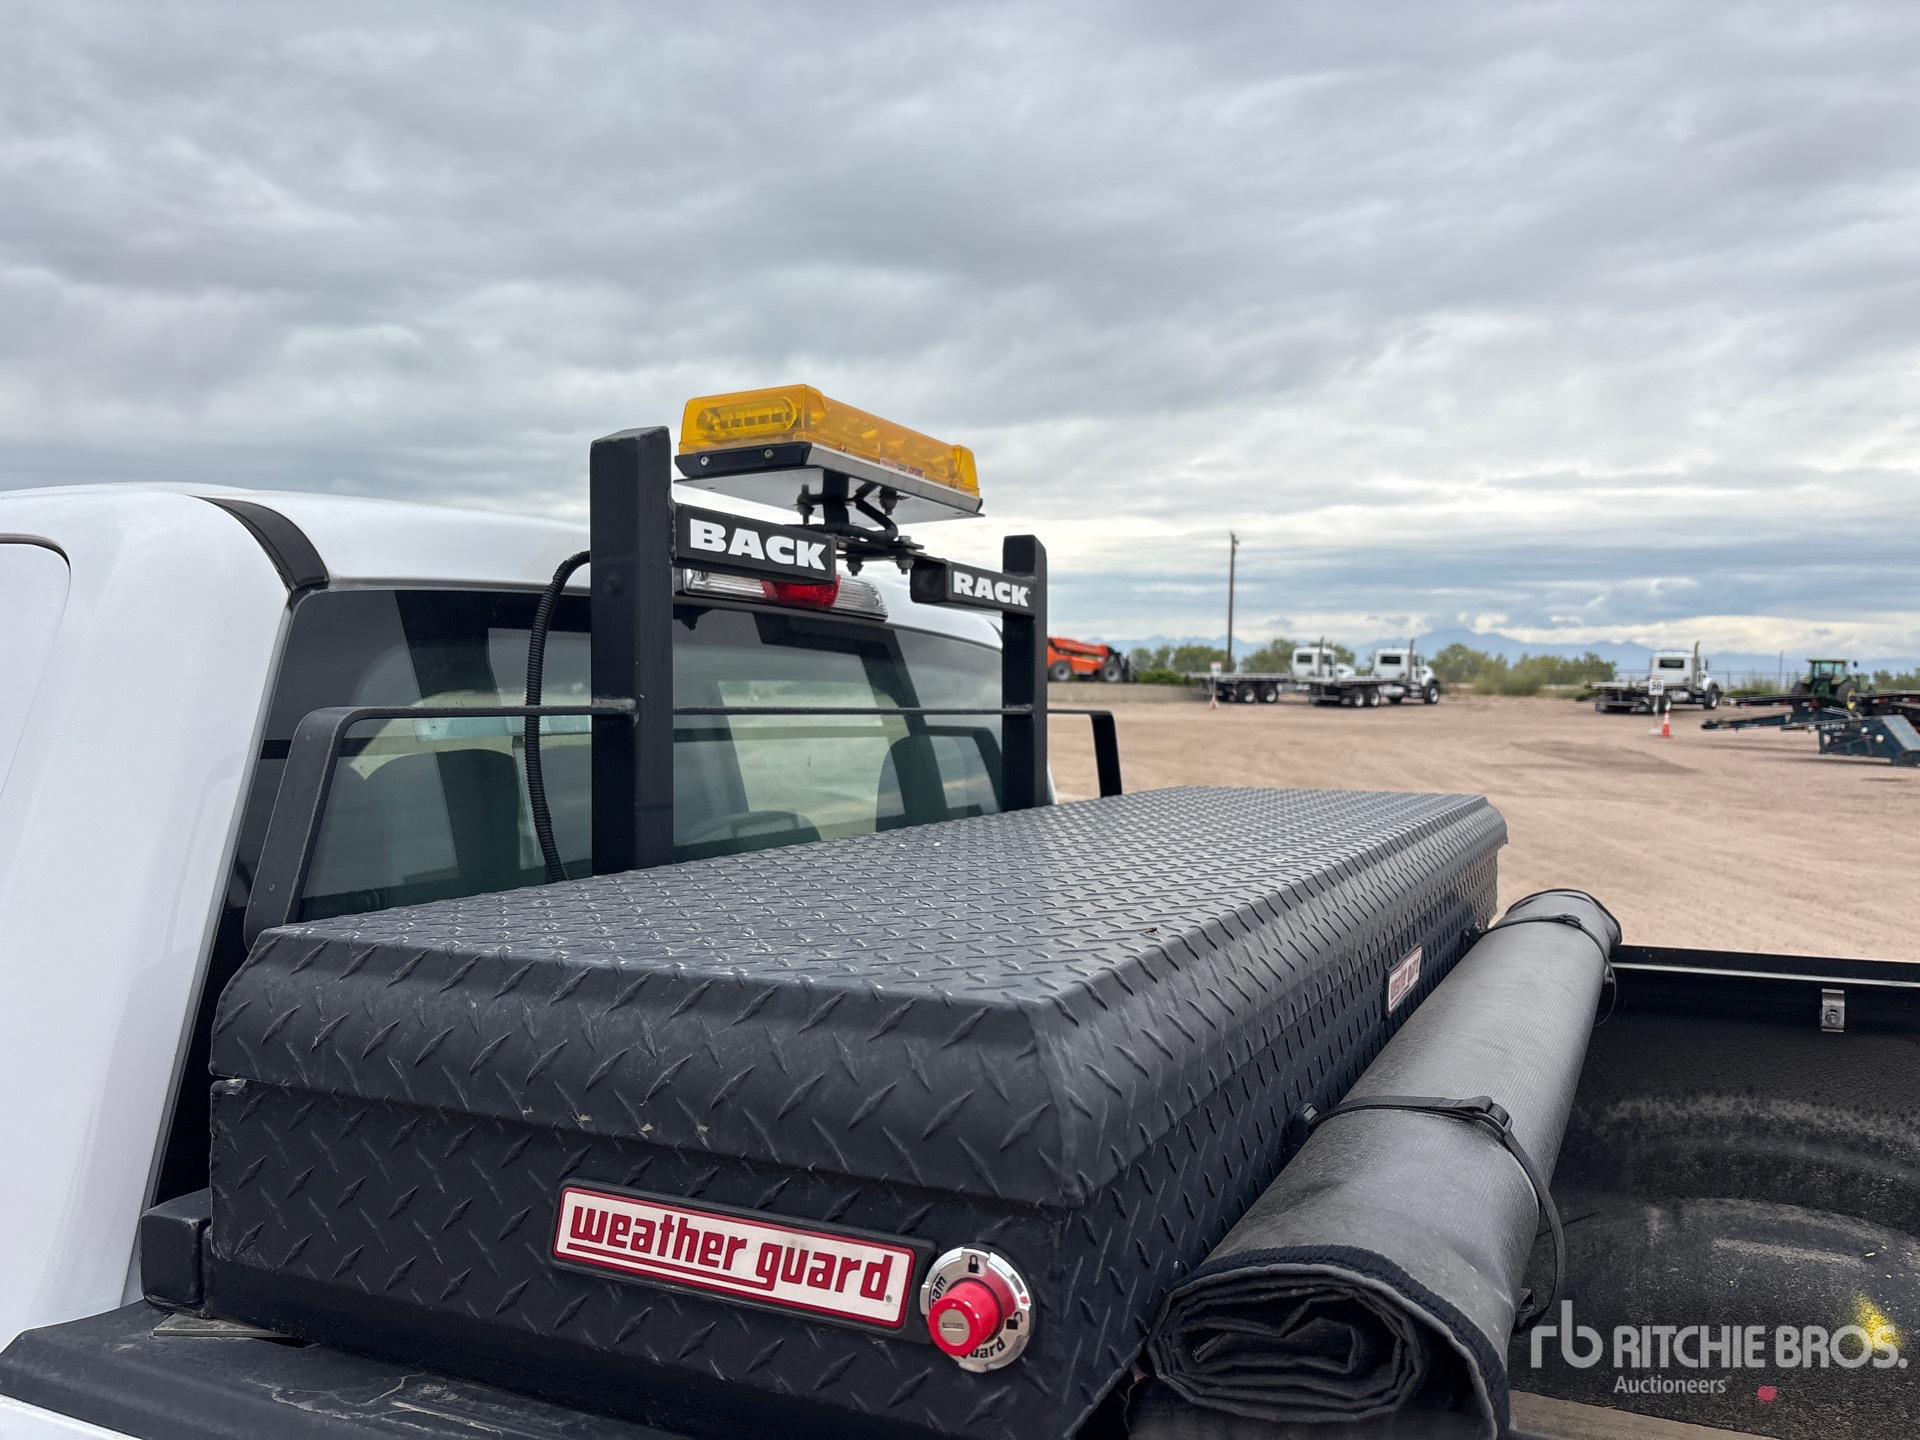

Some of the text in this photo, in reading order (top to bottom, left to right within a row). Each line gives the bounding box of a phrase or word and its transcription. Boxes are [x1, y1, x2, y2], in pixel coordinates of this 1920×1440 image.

[689, 518, 826, 571] BACK
[953, 571, 1029, 607] RACK
[570, 1206, 747, 1270] weather
[755, 1242, 893, 1302] guard
[961, 1337, 1006, 1359] uard
